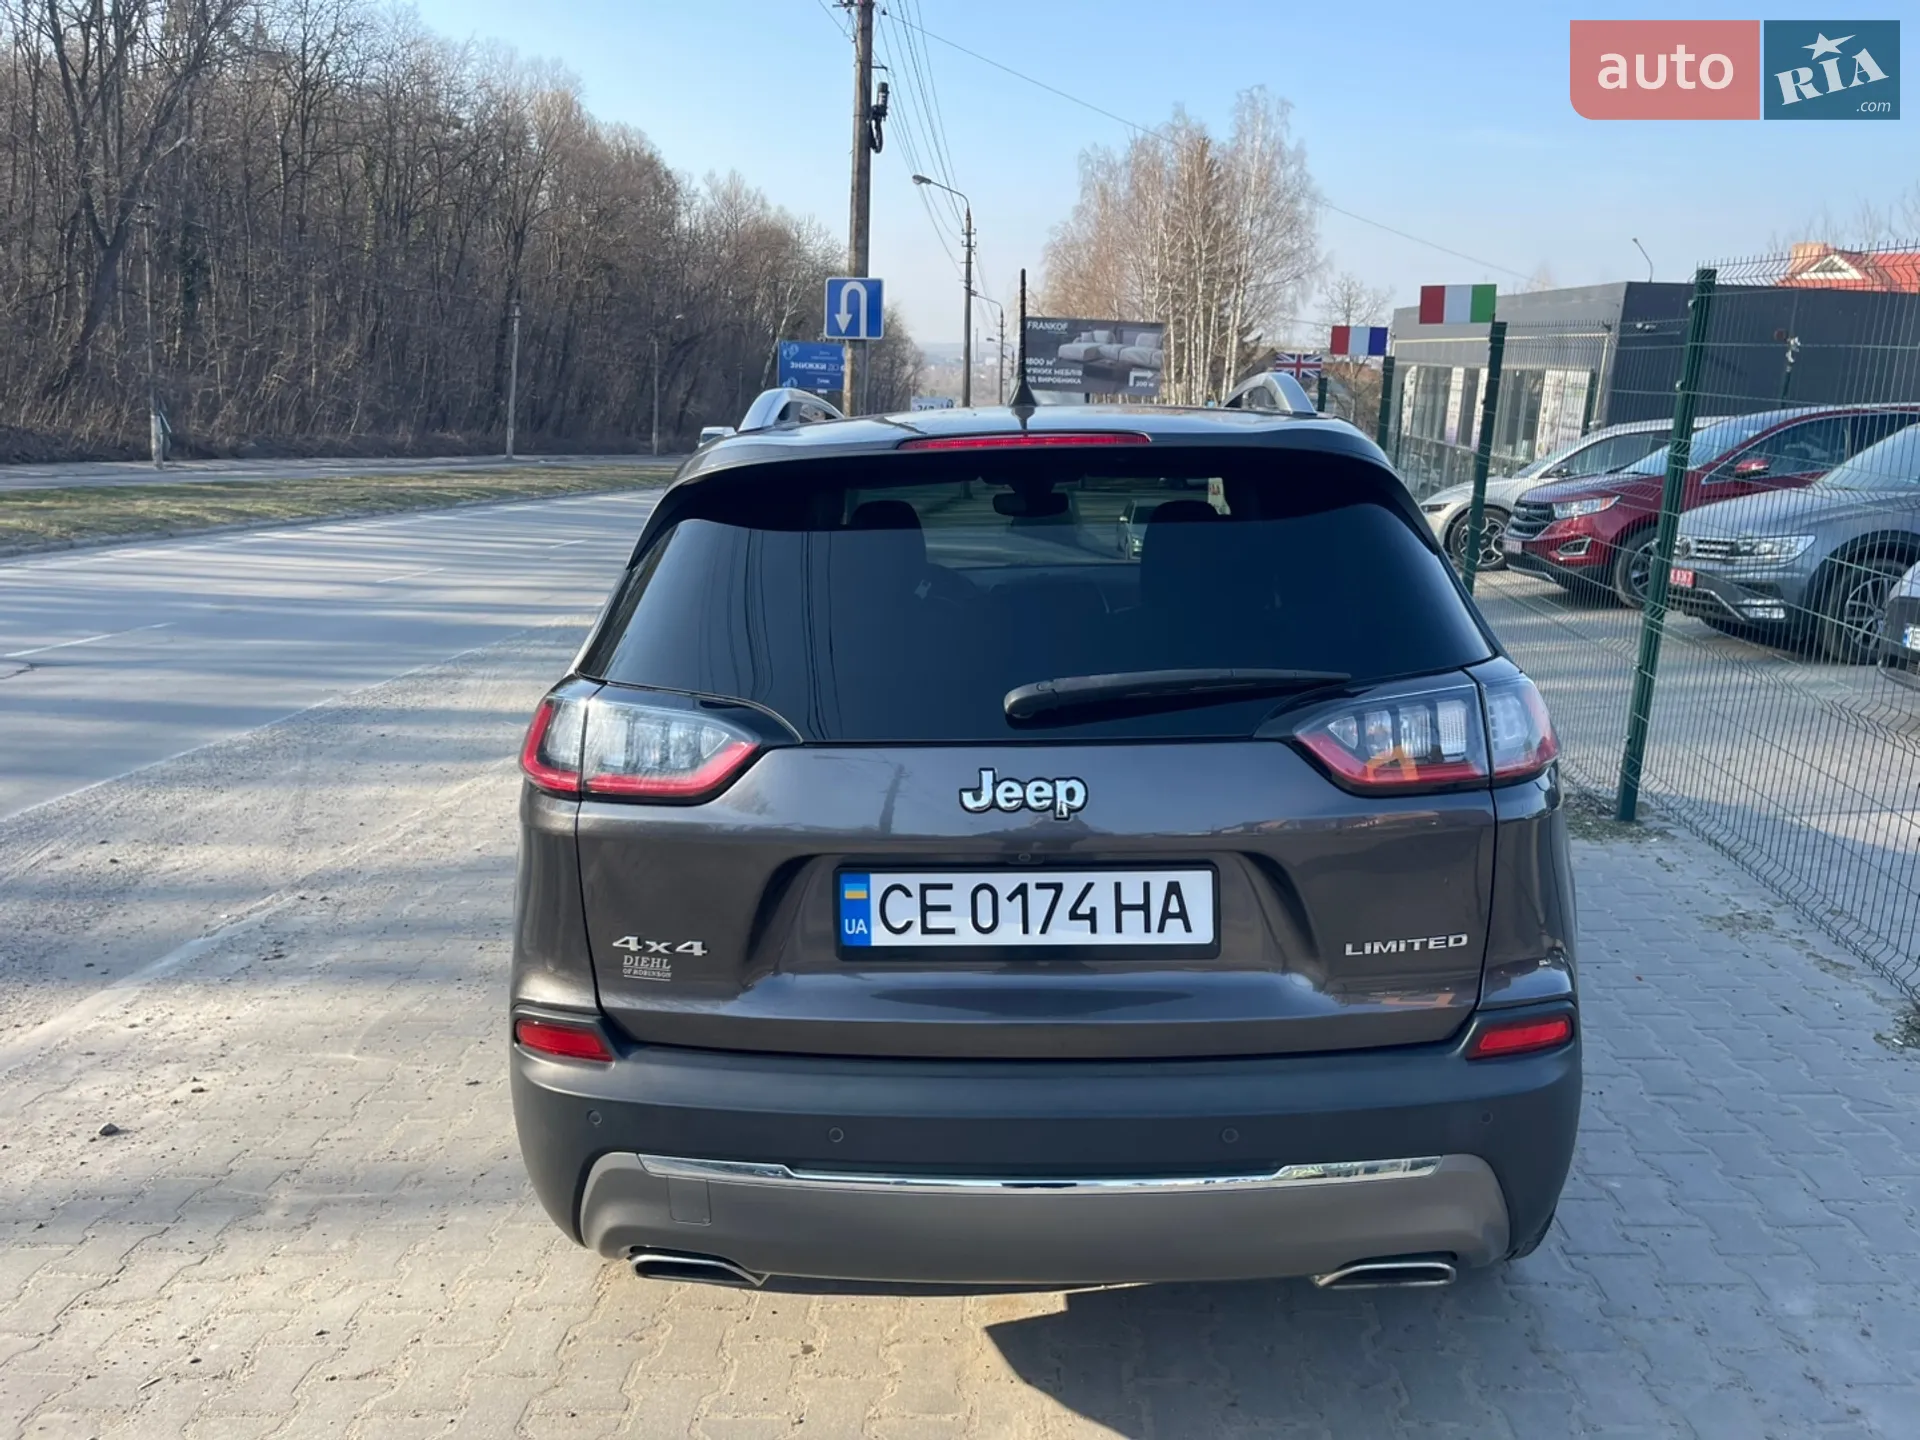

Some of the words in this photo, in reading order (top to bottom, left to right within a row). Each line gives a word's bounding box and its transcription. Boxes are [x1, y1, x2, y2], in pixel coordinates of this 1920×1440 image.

[959, 768, 1088, 820] Jeep
[878, 882, 956, 935] CE
[969, 881, 1098, 935] 0174
[1113, 880, 1193, 933] HA
[845, 918, 868, 935] UA
[612, 936, 708, 956] 4x4
[1345, 933, 1468, 956] LIMITED
[622, 955, 671, 969] DIEHL
